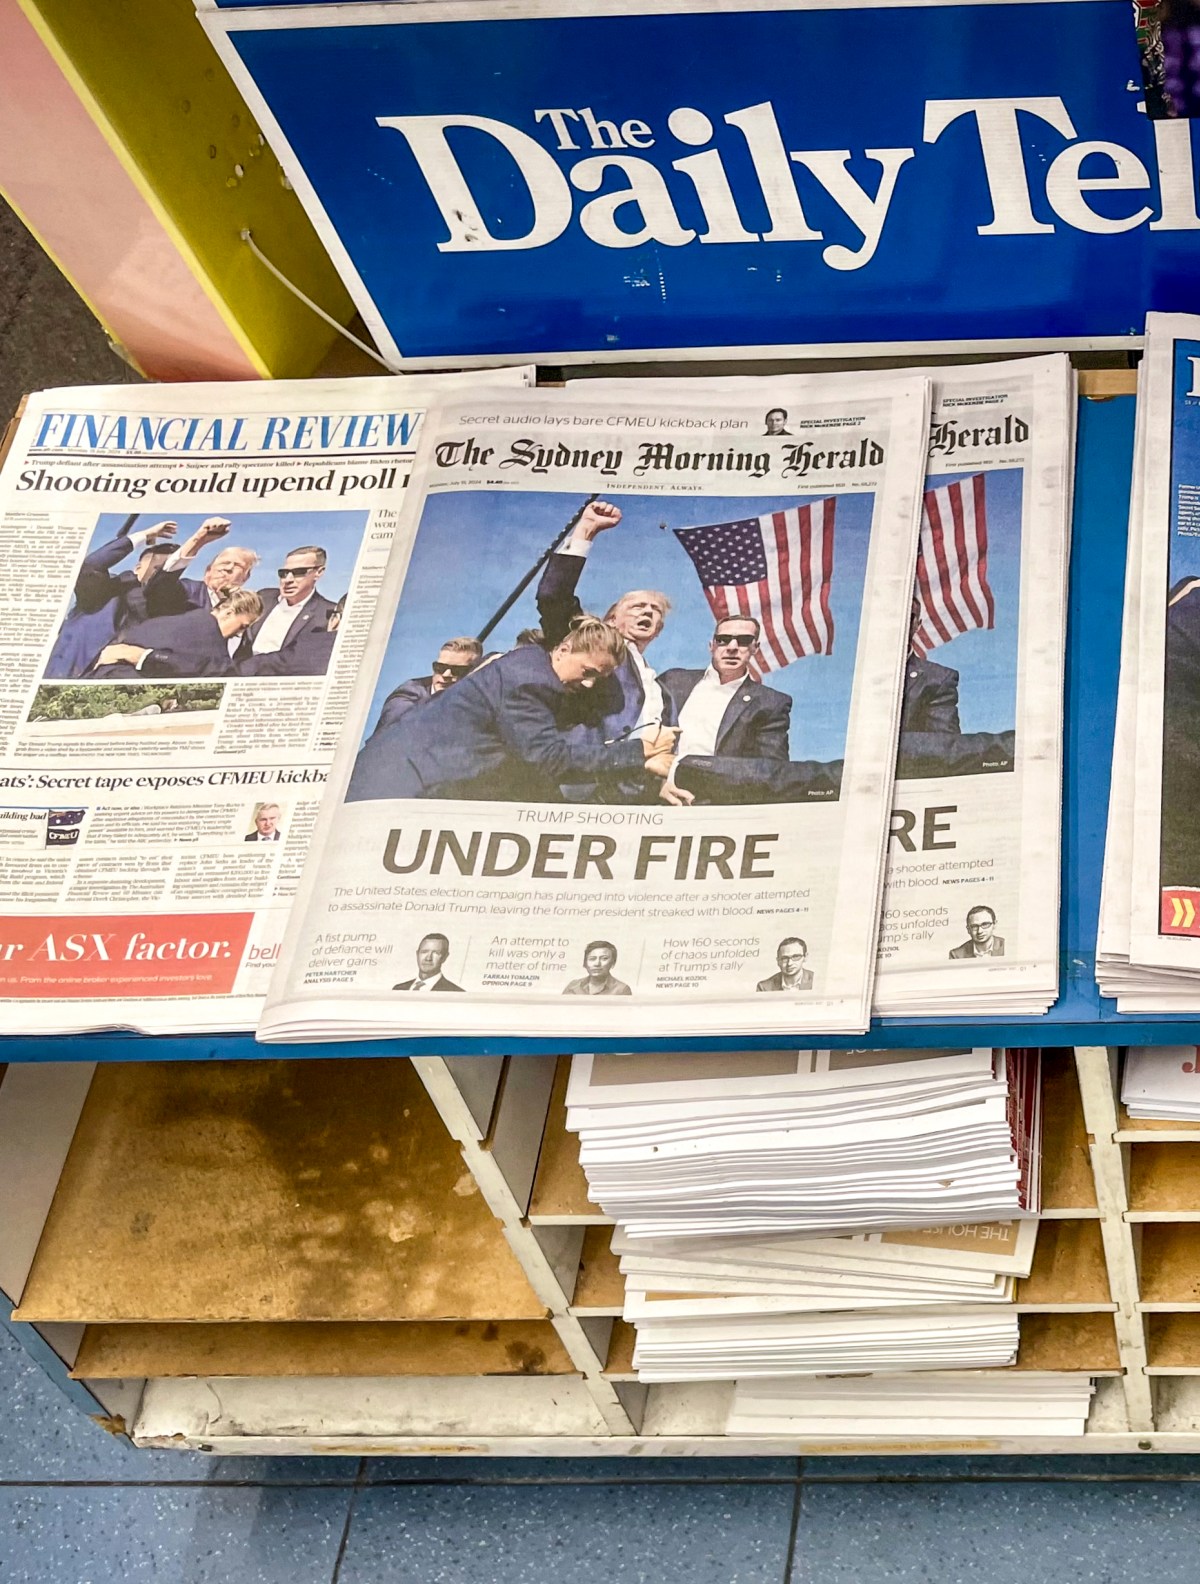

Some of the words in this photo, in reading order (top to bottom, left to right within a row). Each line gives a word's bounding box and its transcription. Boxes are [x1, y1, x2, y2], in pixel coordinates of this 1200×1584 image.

[534, 106, 654, 151] The
[375, 101, 916, 271] Daily
[459, 415, 500, 425] Secret
[503, 415, 541, 425] audio
[544, 415, 570, 427] lays
[573, 416, 604, 426] bare
[606, 416, 658, 428] CFMEU
[659, 417, 717, 429] kickback
[719, 418, 749, 430] plan
[33, 413, 249, 451] FINANCIAL
[257, 412, 425, 450] REVIEW
[928, 412, 1029, 458] Herald
[435, 437, 495, 472] The
[498, 438, 623, 476] Sydney
[633, 442, 771, 478] Morning
[781, 438, 884, 479] Herald
[16, 468, 151, 499] Shooting
[154, 472, 237, 493] could
[242, 469, 336, 498] upend
[338, 468, 397, 497] poll
[378, 508, 398, 518] The
[35, 774, 92, 789] Secret
[95, 773, 134, 792] tape
[136, 772, 205, 791] exposes
[208, 770, 274, 787] CFMEU
[29, 811, 47, 821] bad
[516, 809, 573, 825] TRUMP
[576, 811, 664, 826] SHOOTING
[48, 829, 80, 842] CFMEU
[381, 827, 620, 880] UNDER
[632, 832, 779, 881] FIRE
[333, 887, 353, 897] The
[356, 886, 392, 896] United
[394, 886, 427, 897] States
[430, 887, 474, 898] election
[476, 889, 532, 902] campaign
[535, 890, 553, 900] has
[555, 890, 602, 903] plunged
[604, 891, 626, 902] into
[628, 891, 673, 902] violence
[674, 891, 701, 902] after
[703, 893, 710, 901] a
[711, 890, 751, 901] shooter
[754, 888, 810, 901] attempted
[27, 933, 116, 961] ASX
[123, 932, 231, 961] factor.
[315, 934, 323, 943] A
[324, 933, 341, 943] fist
[342, 934, 377, 945] pump
[248, 943, 281, 960] bell
[312, 945, 323, 955] of
[324, 944, 373, 955] defiance
[375, 944, 394, 954] will
[308, 957, 345, 968] deliver
[347, 957, 378, 968] gains
[20, 976, 42, 984] From
[58, 976, 82, 984] online
[110, 975, 158, 984] experienced
[159, 974, 192, 982] investors
[981, 1225, 1009, 1242] THE
